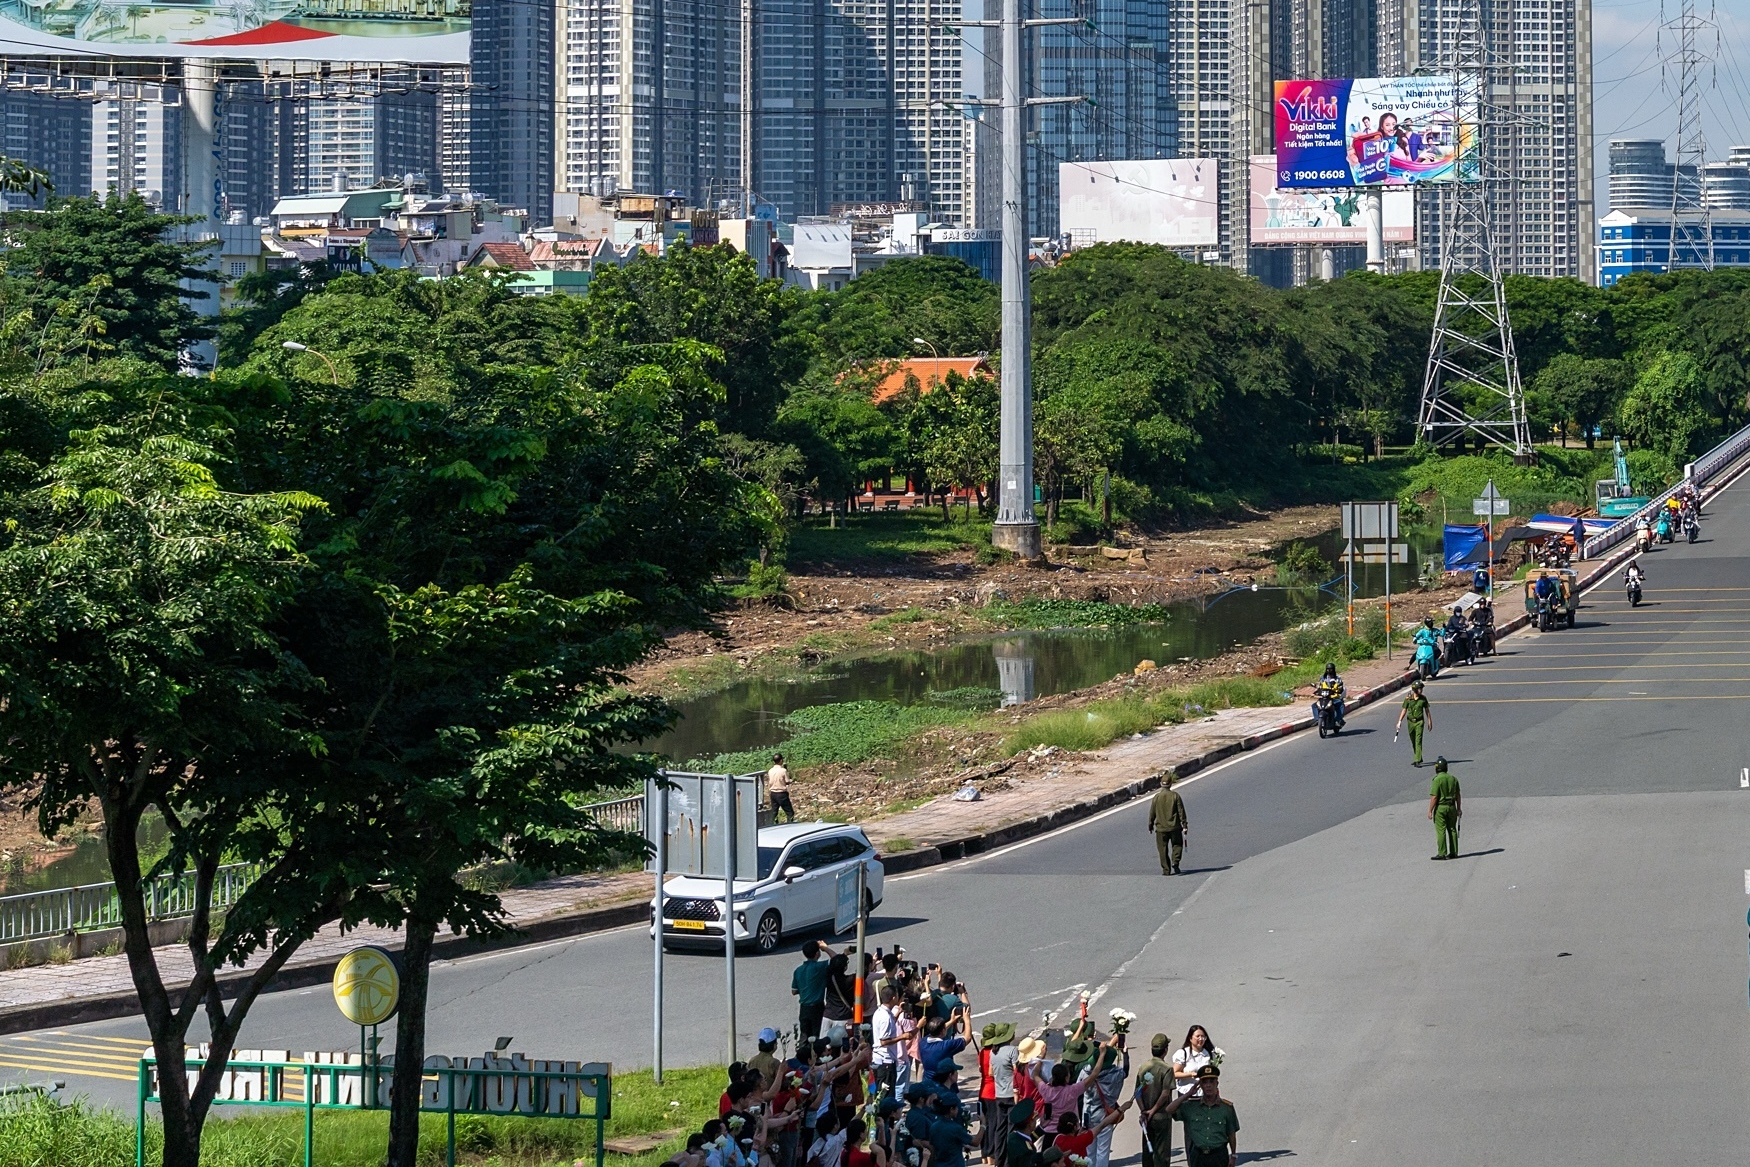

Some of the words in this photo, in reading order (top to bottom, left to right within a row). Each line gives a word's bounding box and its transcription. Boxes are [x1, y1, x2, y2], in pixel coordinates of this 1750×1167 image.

[1406, 89, 1433, 98] Nhanh
[1279, 86, 1338, 122] Vikki
[1371, 102, 1394, 111] Sáng
[1437, 100, 1449, 108] có
[1289, 123, 1316, 132] Digital
[1316, 122, 1337, 131] Bank
[1296, 133, 1313, 141] Ngân
[1314, 132, 1331, 141] hàng
[1373, 140, 1389, 154] 10
[1294, 171, 1318, 180] 1900
[1319, 170, 1346, 180] 6608
[333, 263, 358, 272] YUAN
